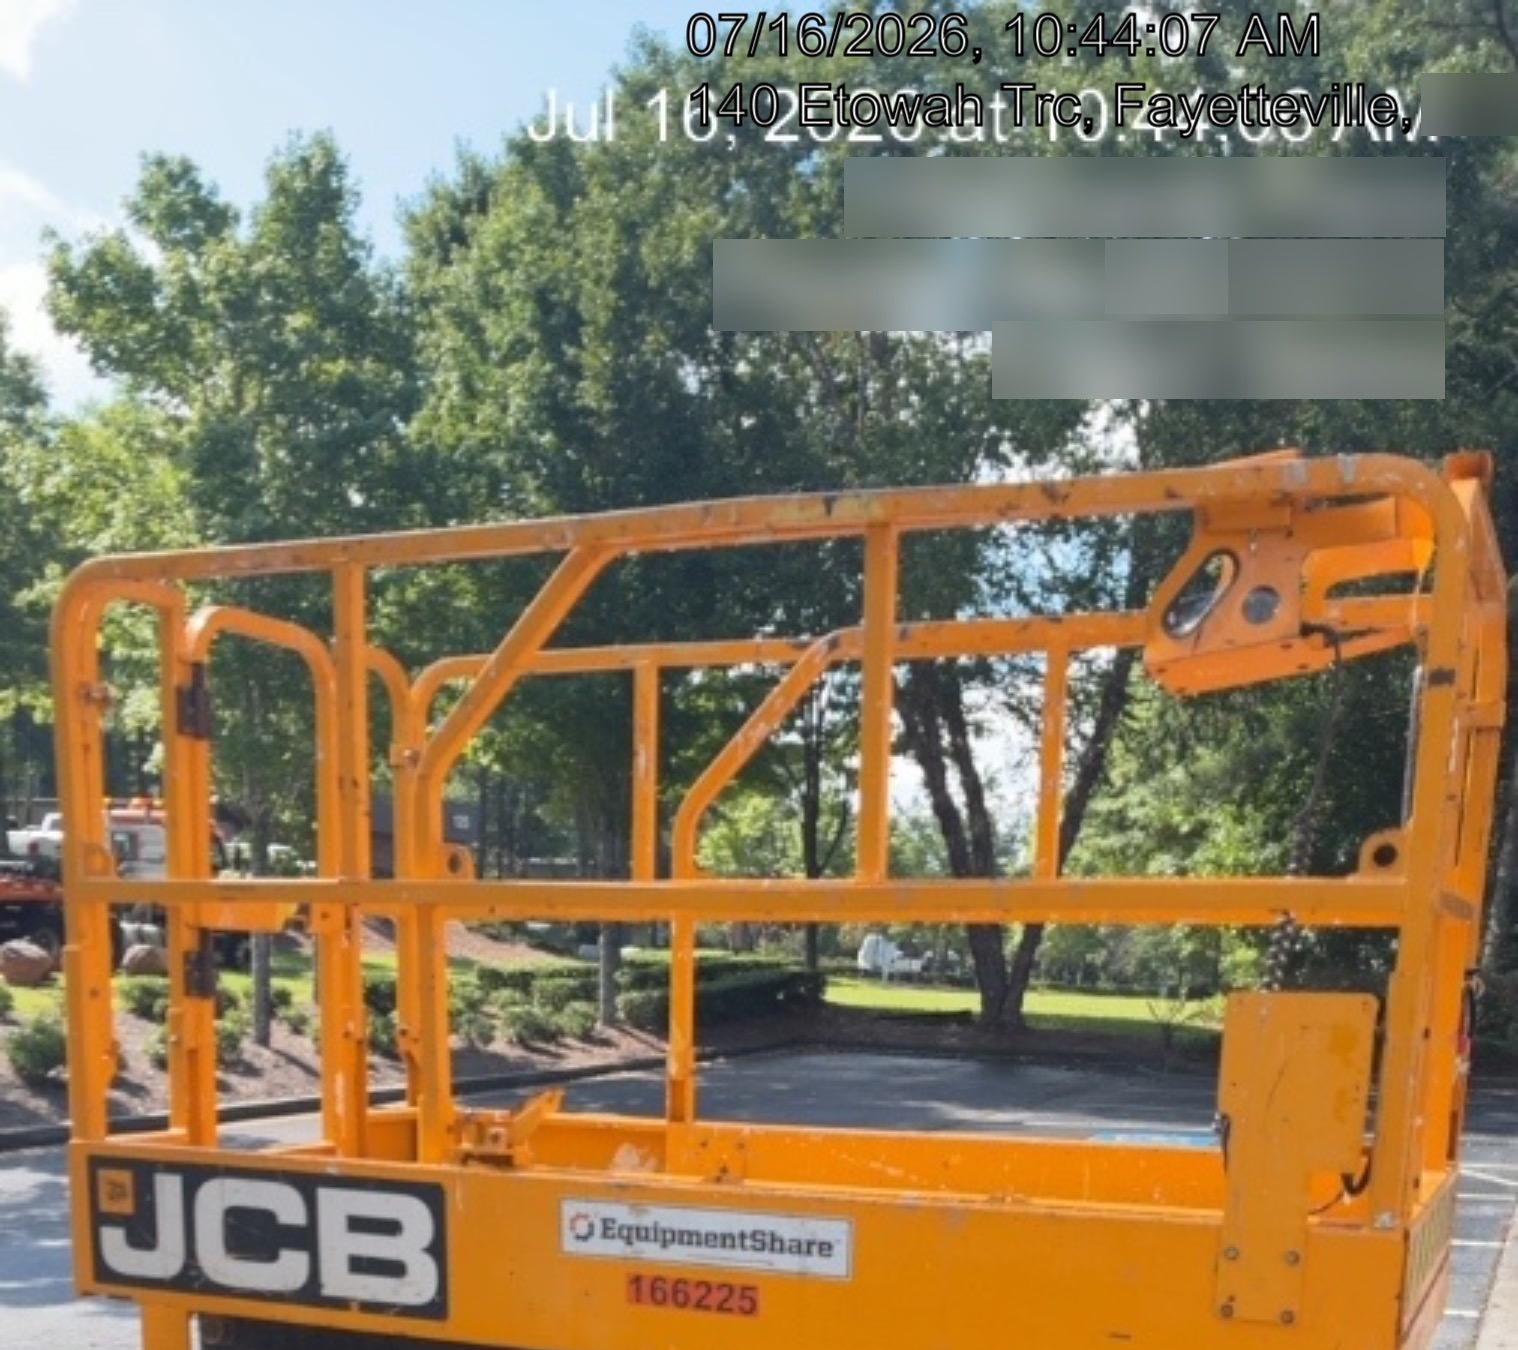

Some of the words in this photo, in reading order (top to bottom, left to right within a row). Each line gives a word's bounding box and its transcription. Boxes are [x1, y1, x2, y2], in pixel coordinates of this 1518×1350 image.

[99, 1172, 439, 1306] JCB
[599, 1217, 835, 1258] EquipmentShare
[628, 1274, 759, 1316] 166225
